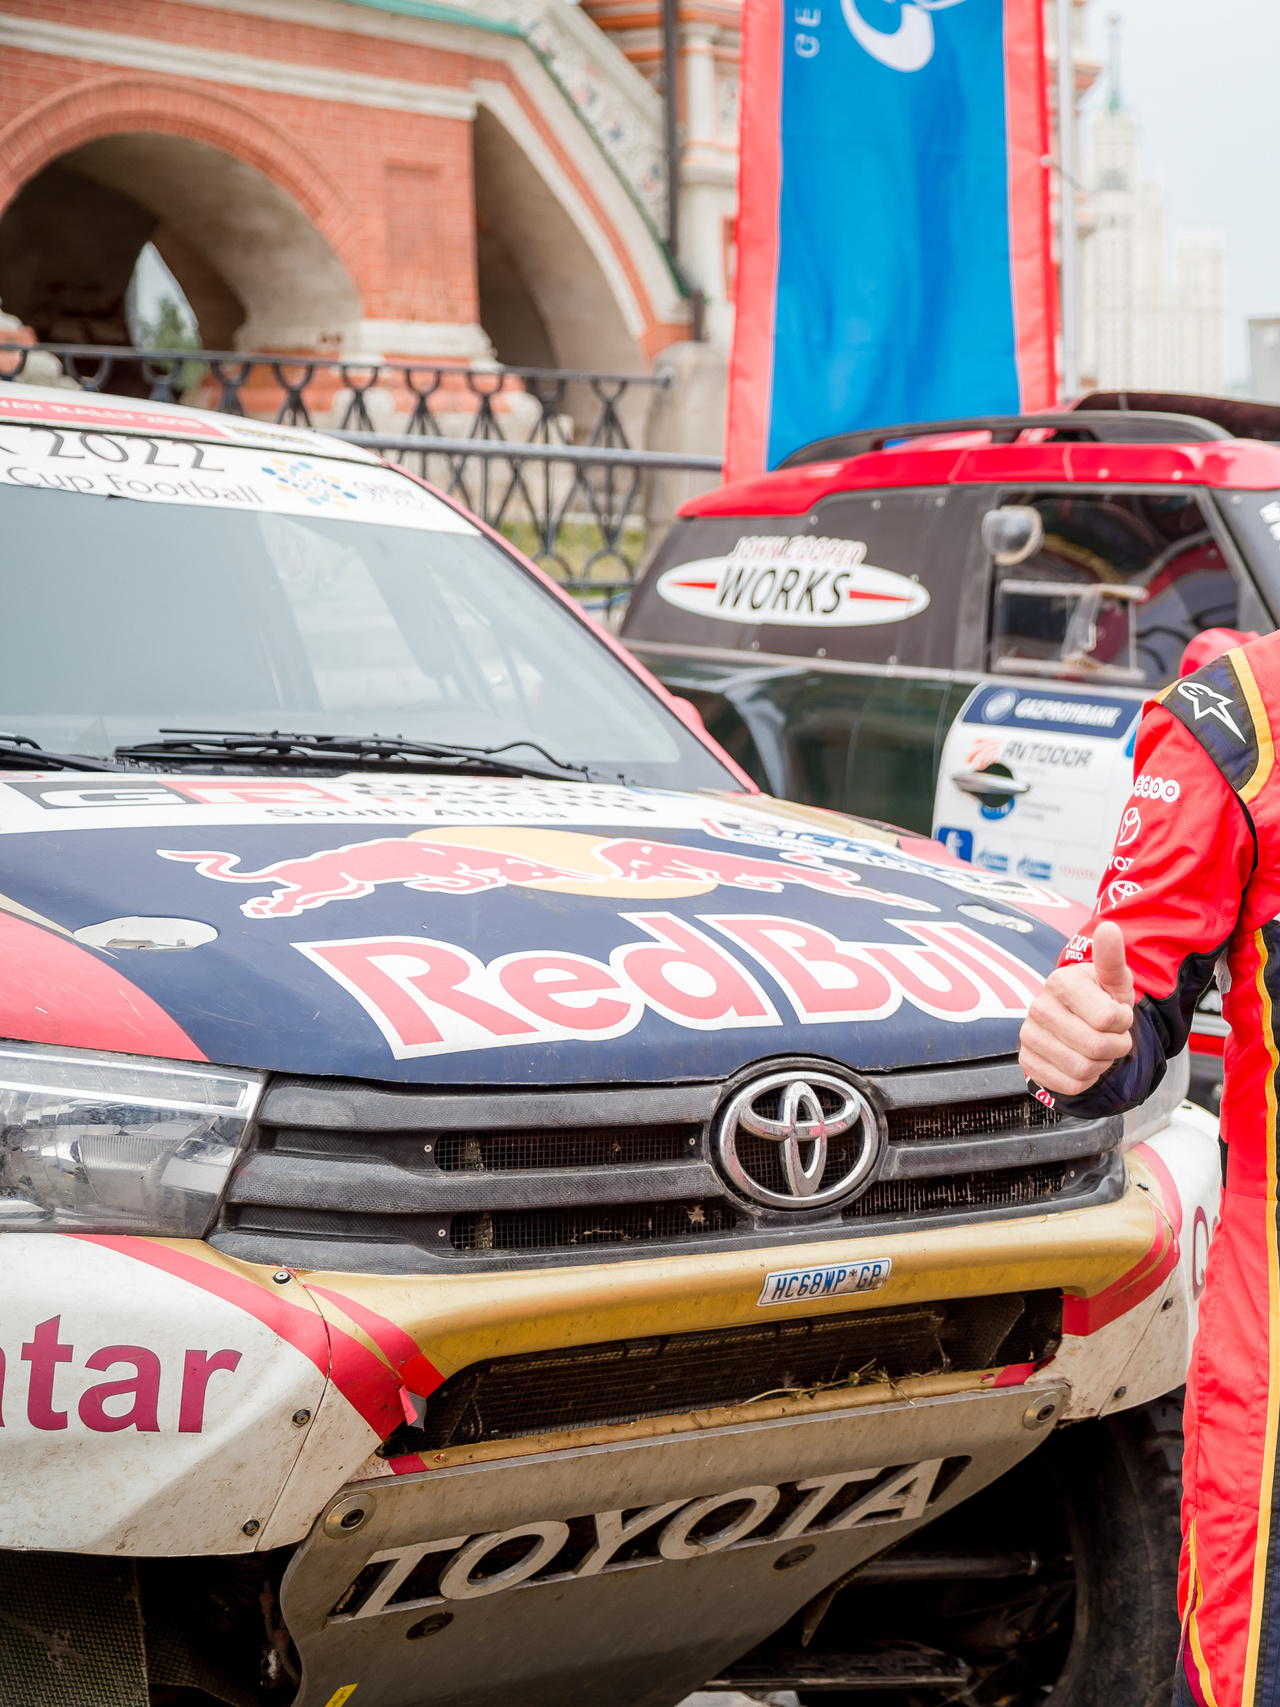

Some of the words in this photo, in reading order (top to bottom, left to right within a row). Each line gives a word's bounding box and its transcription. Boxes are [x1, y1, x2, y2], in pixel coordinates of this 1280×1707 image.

[29, 427, 225, 473] 2022
[6, 466, 95, 493] Cup
[103, 473, 264, 505] Football
[717, 566, 850, 614] WORKS
[1015, 697, 1122, 728] GAZPROMBANK
[264, 807, 417, 819] South
[433, 808, 570, 820] Africa
[289, 911, 784, 1060] Red
[700, 913, 1047, 1023] Bull
[770, 1268, 847, 1301] HC68WP
[856, 1264, 883, 1289] GP
[0, 1314, 243, 1434] tar
[340, 1456, 955, 1621] TOYOTA
